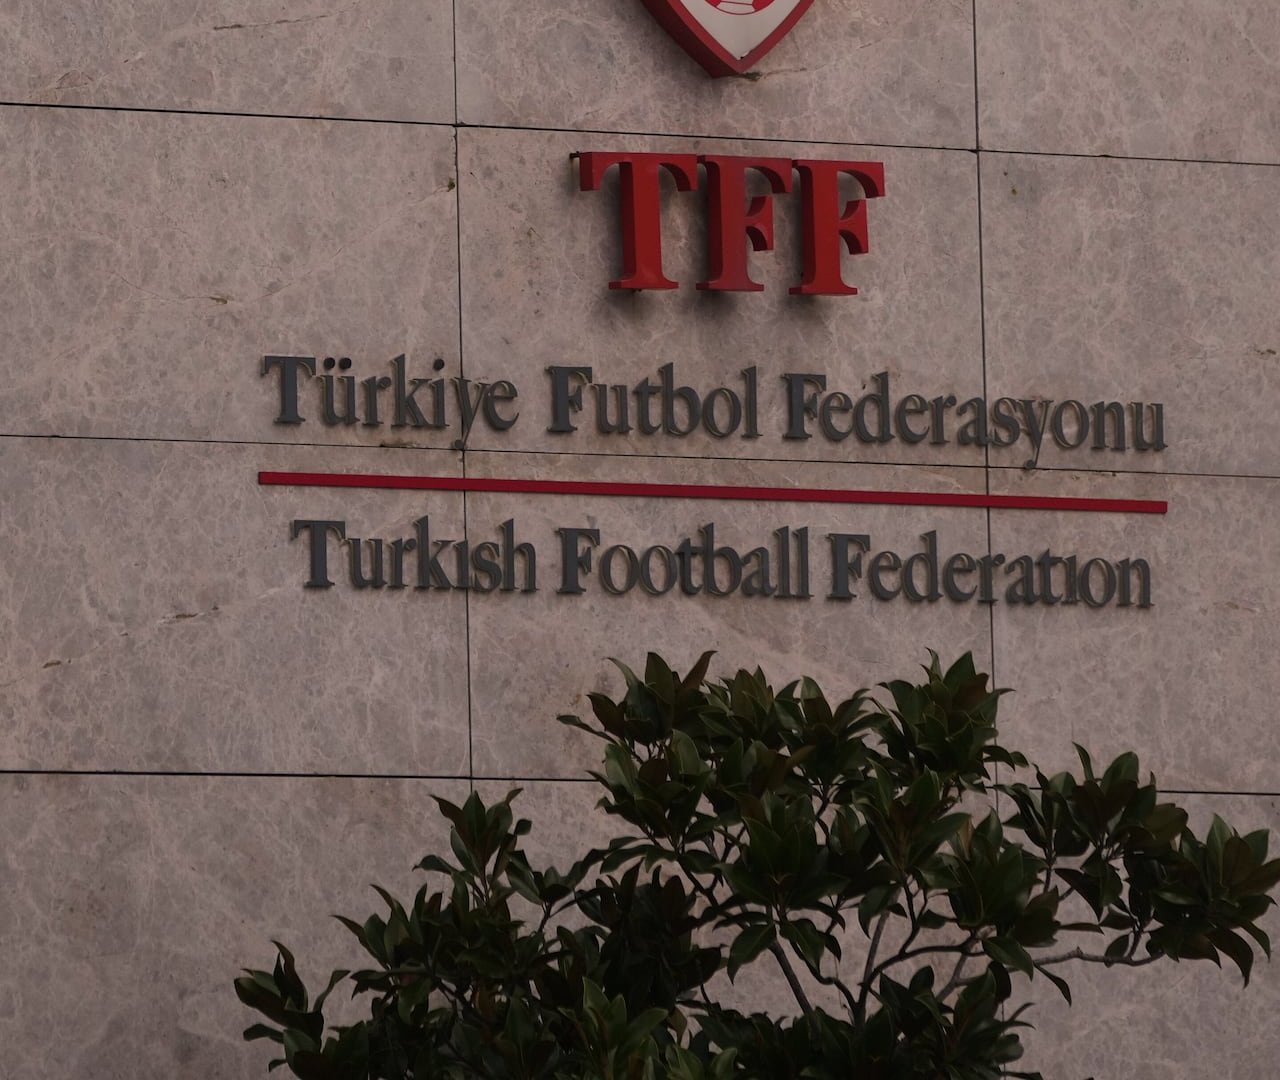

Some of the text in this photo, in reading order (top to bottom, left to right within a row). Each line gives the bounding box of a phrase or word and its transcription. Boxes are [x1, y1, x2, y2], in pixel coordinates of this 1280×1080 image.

[572, 151, 885, 296] TFF
[263, 354, 1168, 470] Türkiye Futbol Federasyonu
[555, 522, 814, 600] Football
